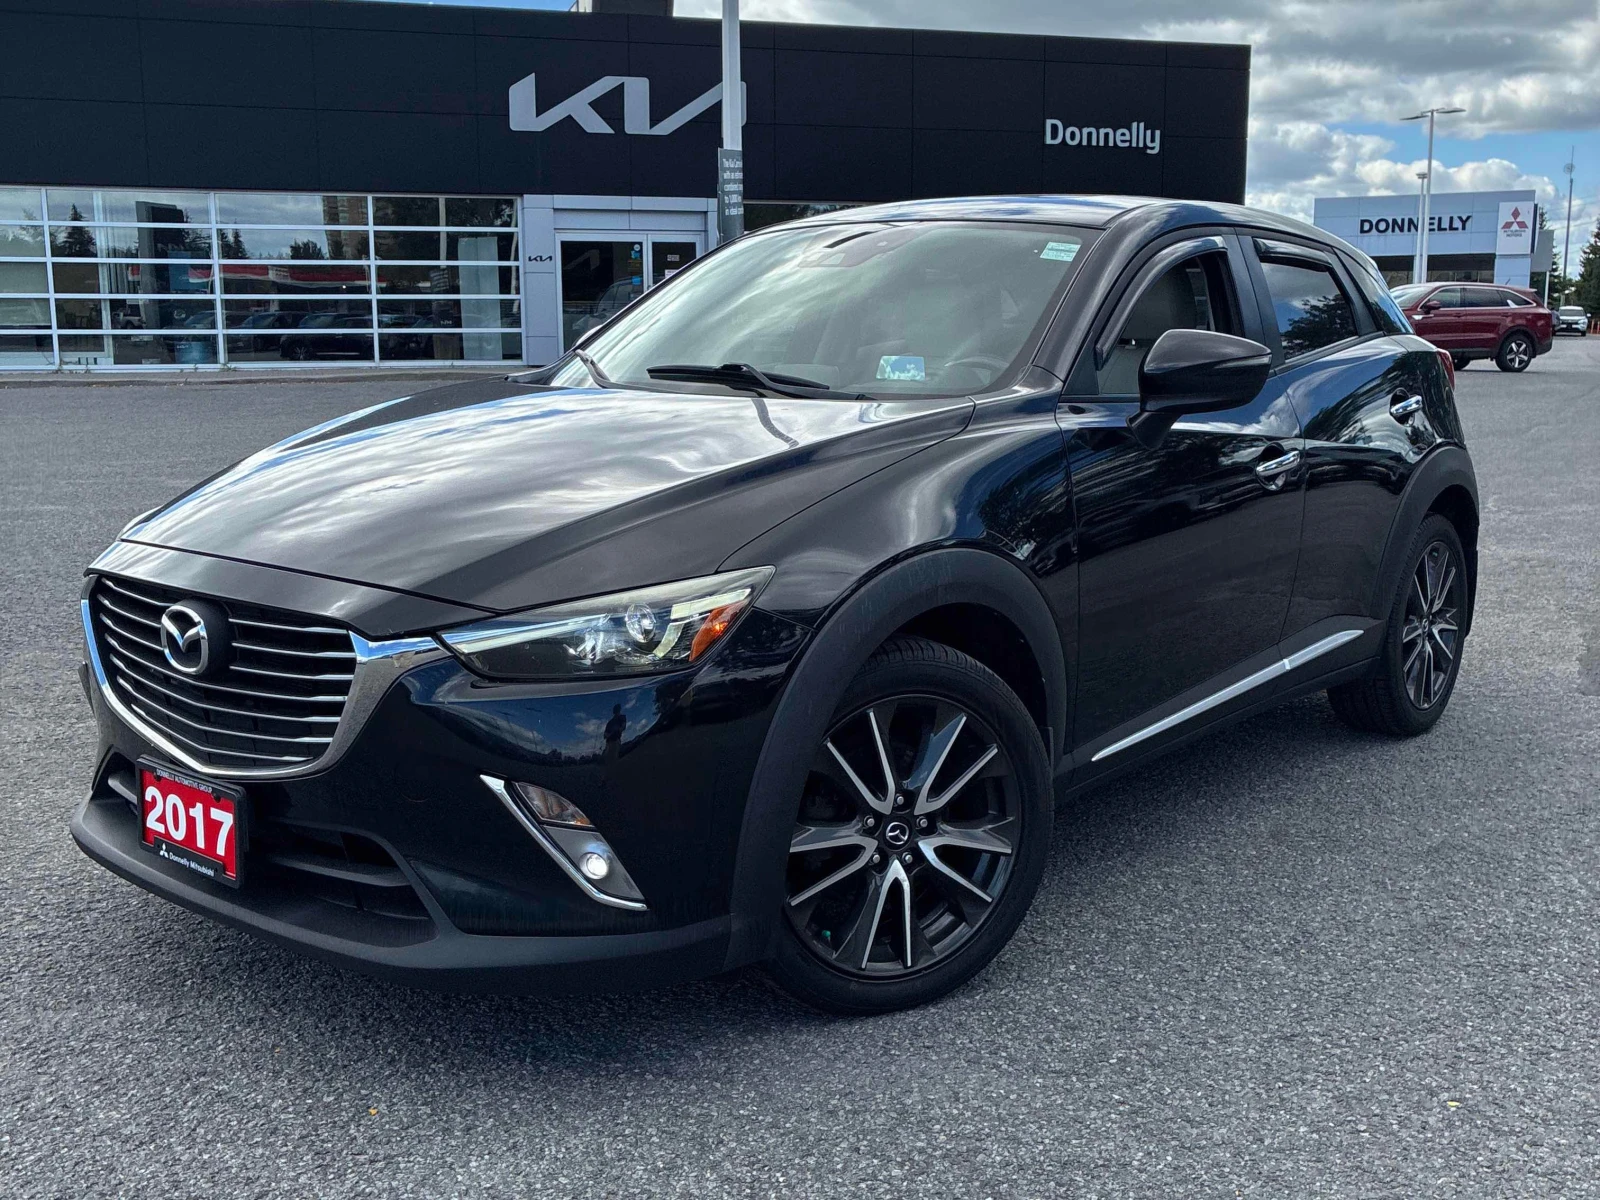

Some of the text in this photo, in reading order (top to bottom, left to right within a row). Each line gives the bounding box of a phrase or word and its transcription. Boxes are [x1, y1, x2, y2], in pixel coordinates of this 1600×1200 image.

[1045, 119, 1160, 154] Donnelly
[1359, 215, 1472, 234] DONNELLY
[199, 784, 213, 793] GROUP
[145, 786, 234, 857] 2017
[169, 852, 214, 877] Donnelly Mitsubishi
